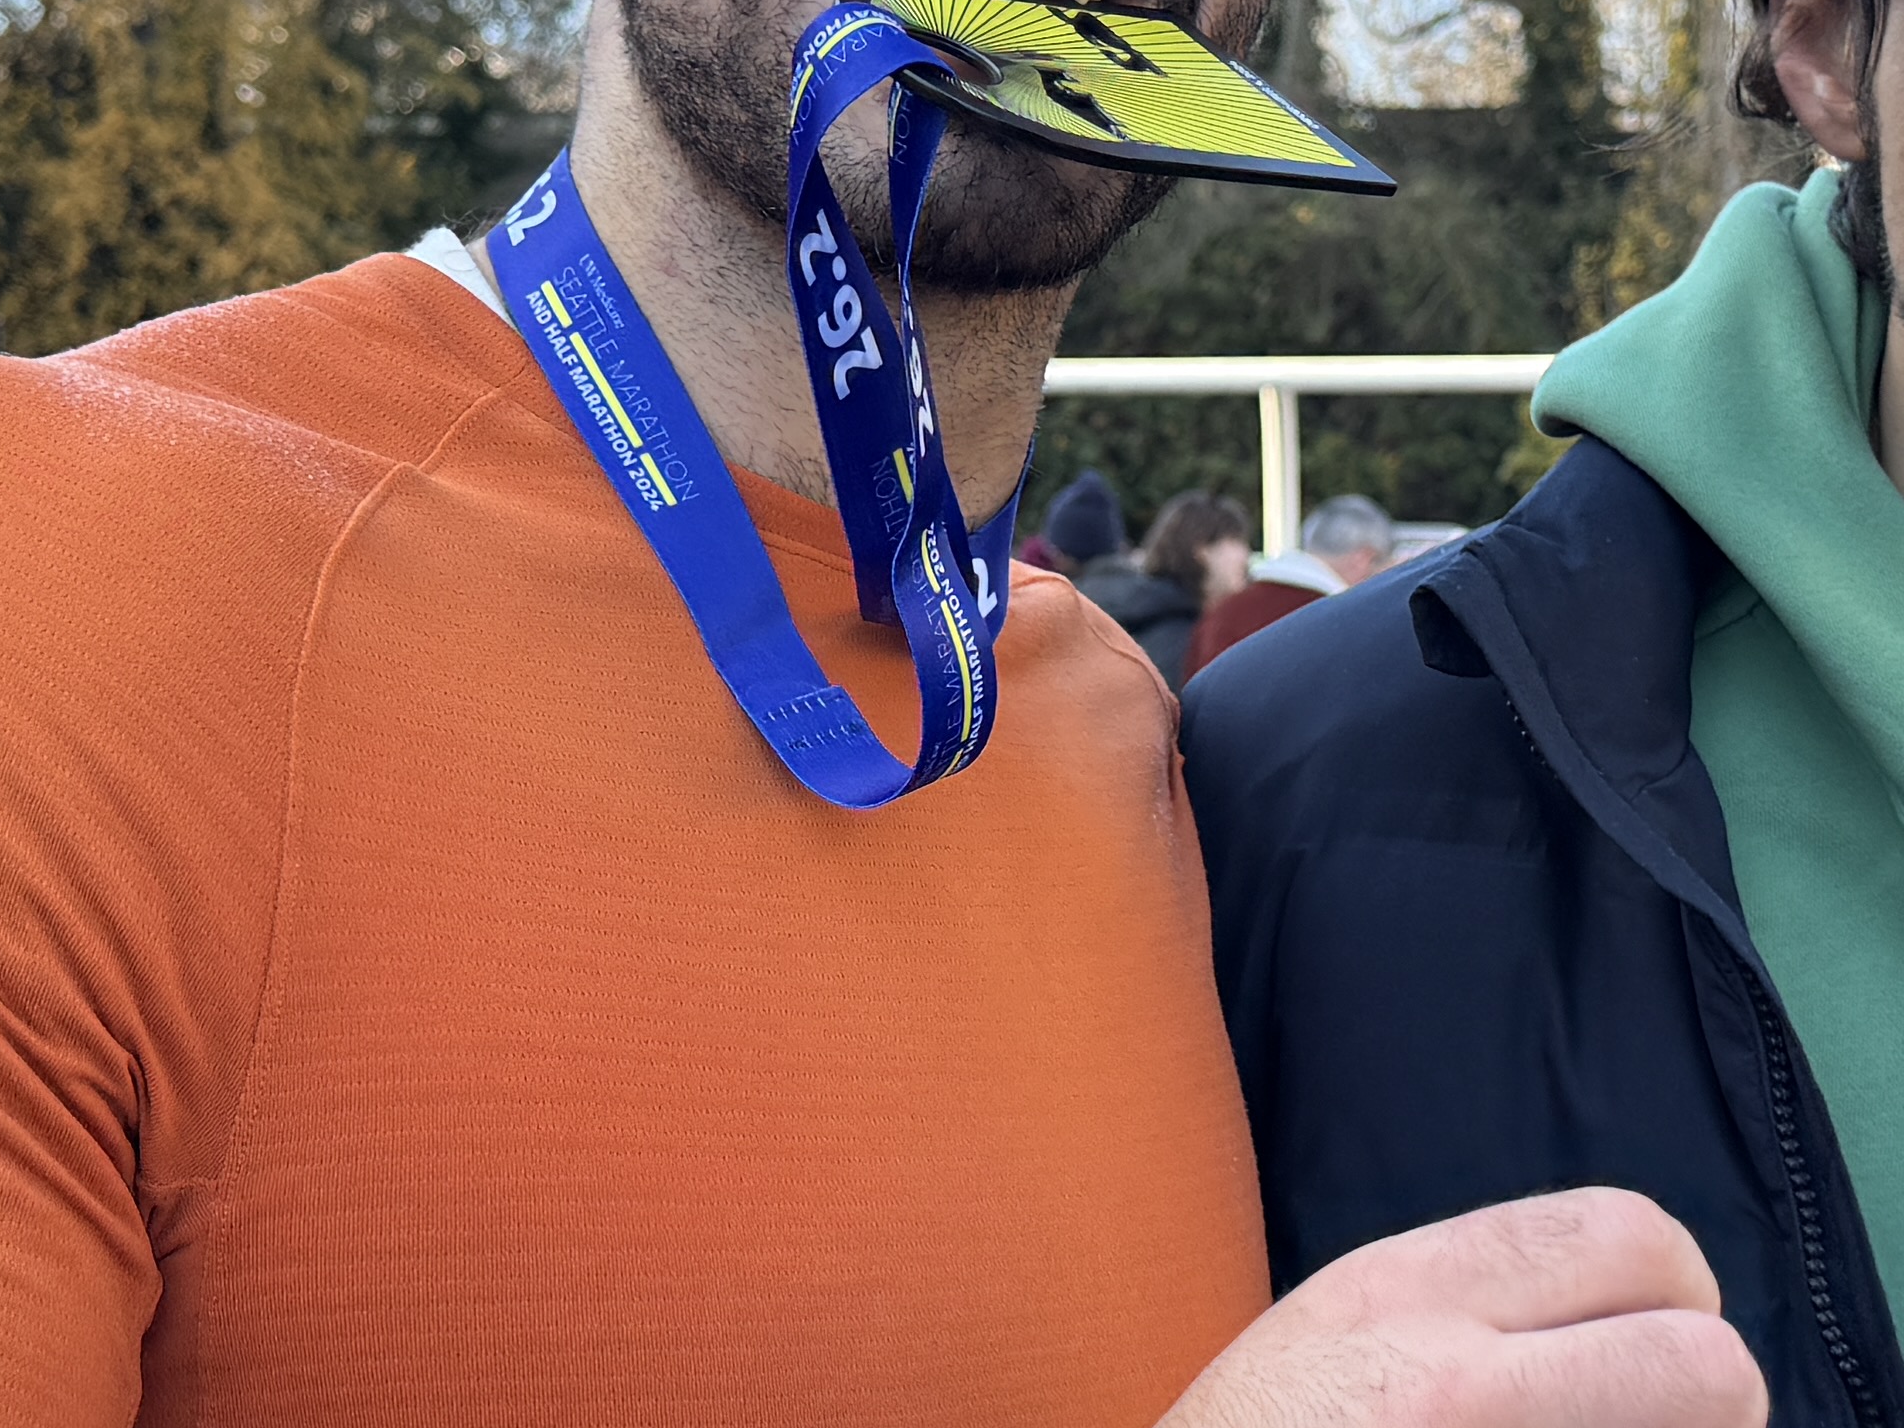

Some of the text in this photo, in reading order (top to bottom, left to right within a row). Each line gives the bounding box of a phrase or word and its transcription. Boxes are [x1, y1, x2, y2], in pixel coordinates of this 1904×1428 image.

[526, 290, 664, 512] AND HALF MARATHON 2024
[553, 266, 700, 502] SEATTLE MARATHON
[799, 208, 883, 401] 26.2
[940, 577, 984, 701] MARATHON
